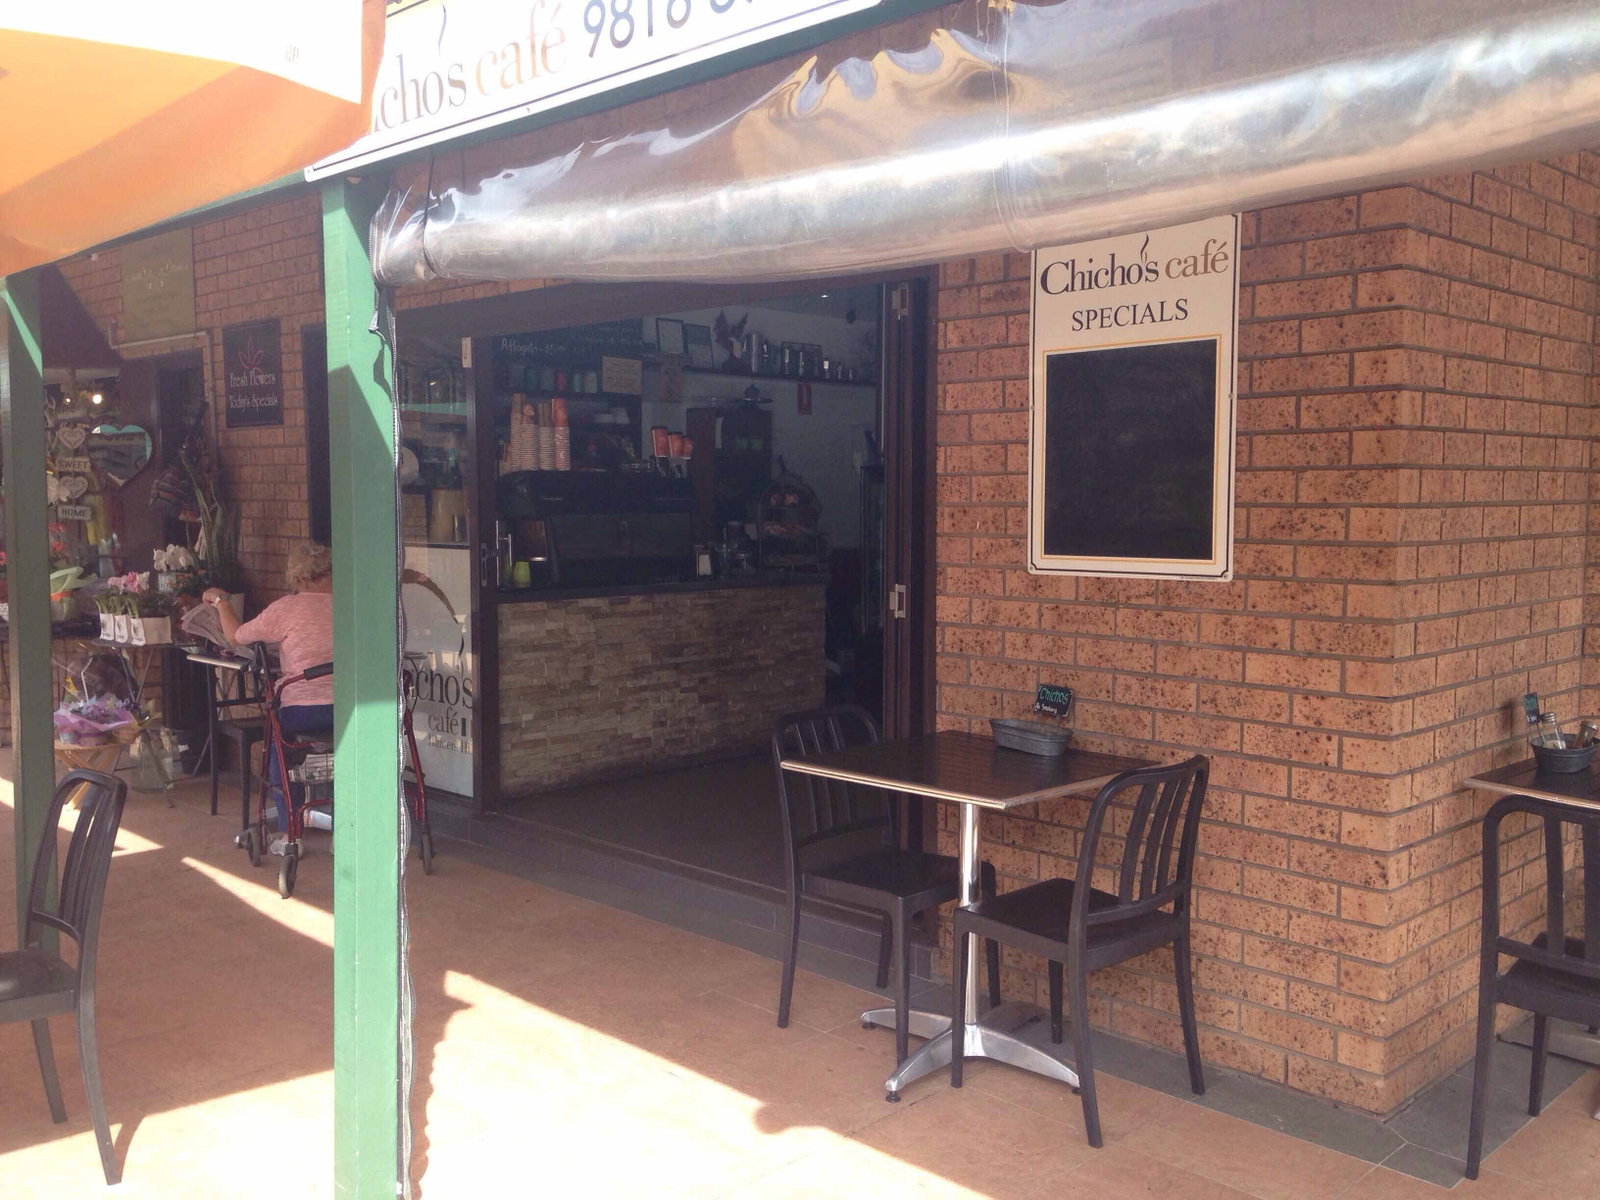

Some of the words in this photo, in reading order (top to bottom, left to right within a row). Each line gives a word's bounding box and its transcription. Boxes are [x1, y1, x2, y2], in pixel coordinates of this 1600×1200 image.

[476, 0, 567, 96] café
[1165, 238, 1229, 280] café
[1071, 298, 1189, 332] SPECIALS
[229, 370, 249, 388] Fresh
[249, 369, 277, 386] Flowers
[251, 392, 279, 413] Specials
[61, 507, 88, 518] HOME
[428, 706, 460, 735] café
